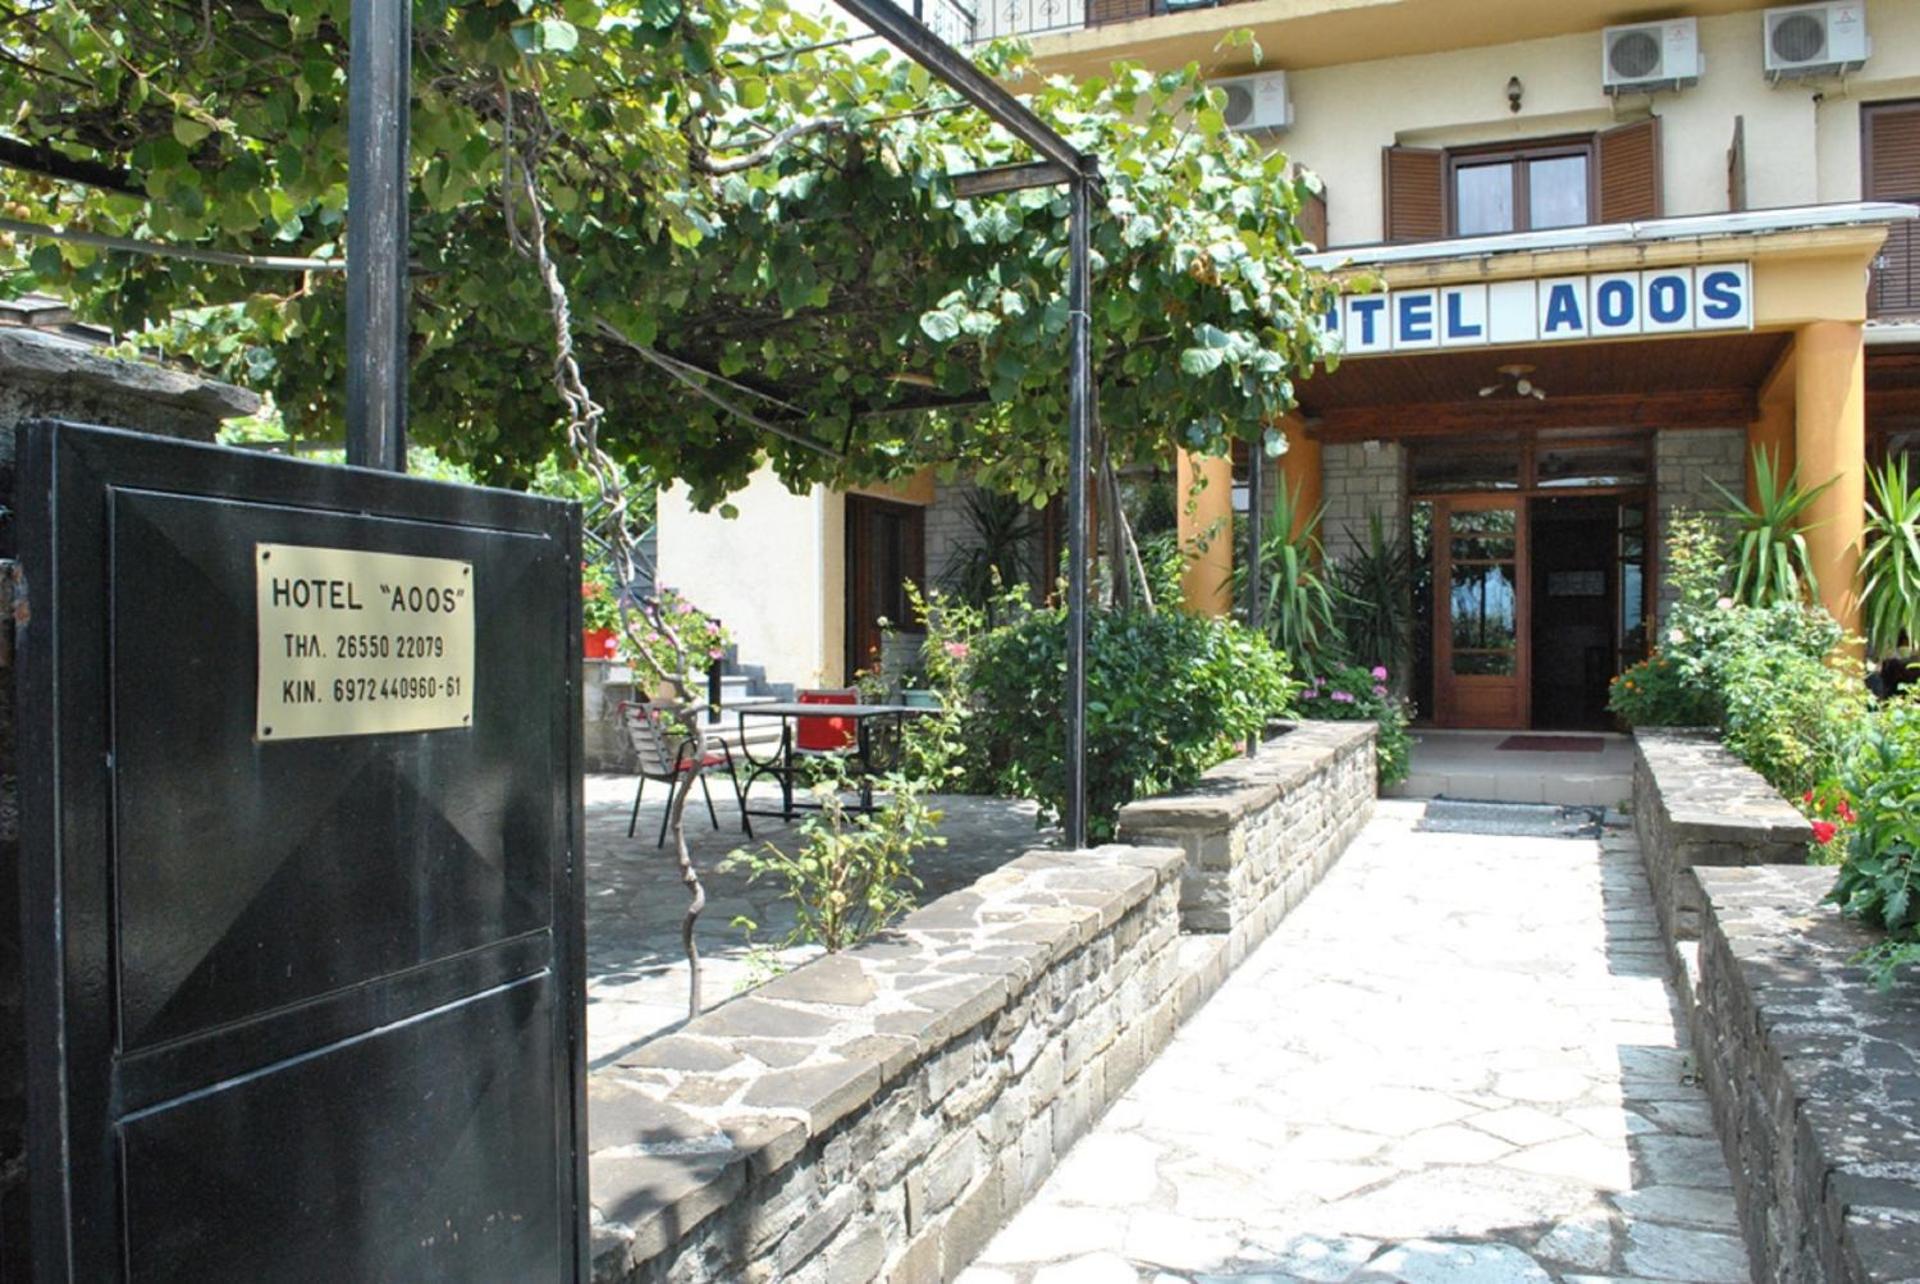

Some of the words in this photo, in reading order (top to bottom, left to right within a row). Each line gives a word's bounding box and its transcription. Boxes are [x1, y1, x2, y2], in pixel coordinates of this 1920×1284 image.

[1326, 292, 1483, 345] TEL
[1544, 270, 1743, 333] AOOS
[273, 578, 363, 610] HOTEL
[337, 635, 389, 659] 26550
[397, 636, 443, 659] 22079
